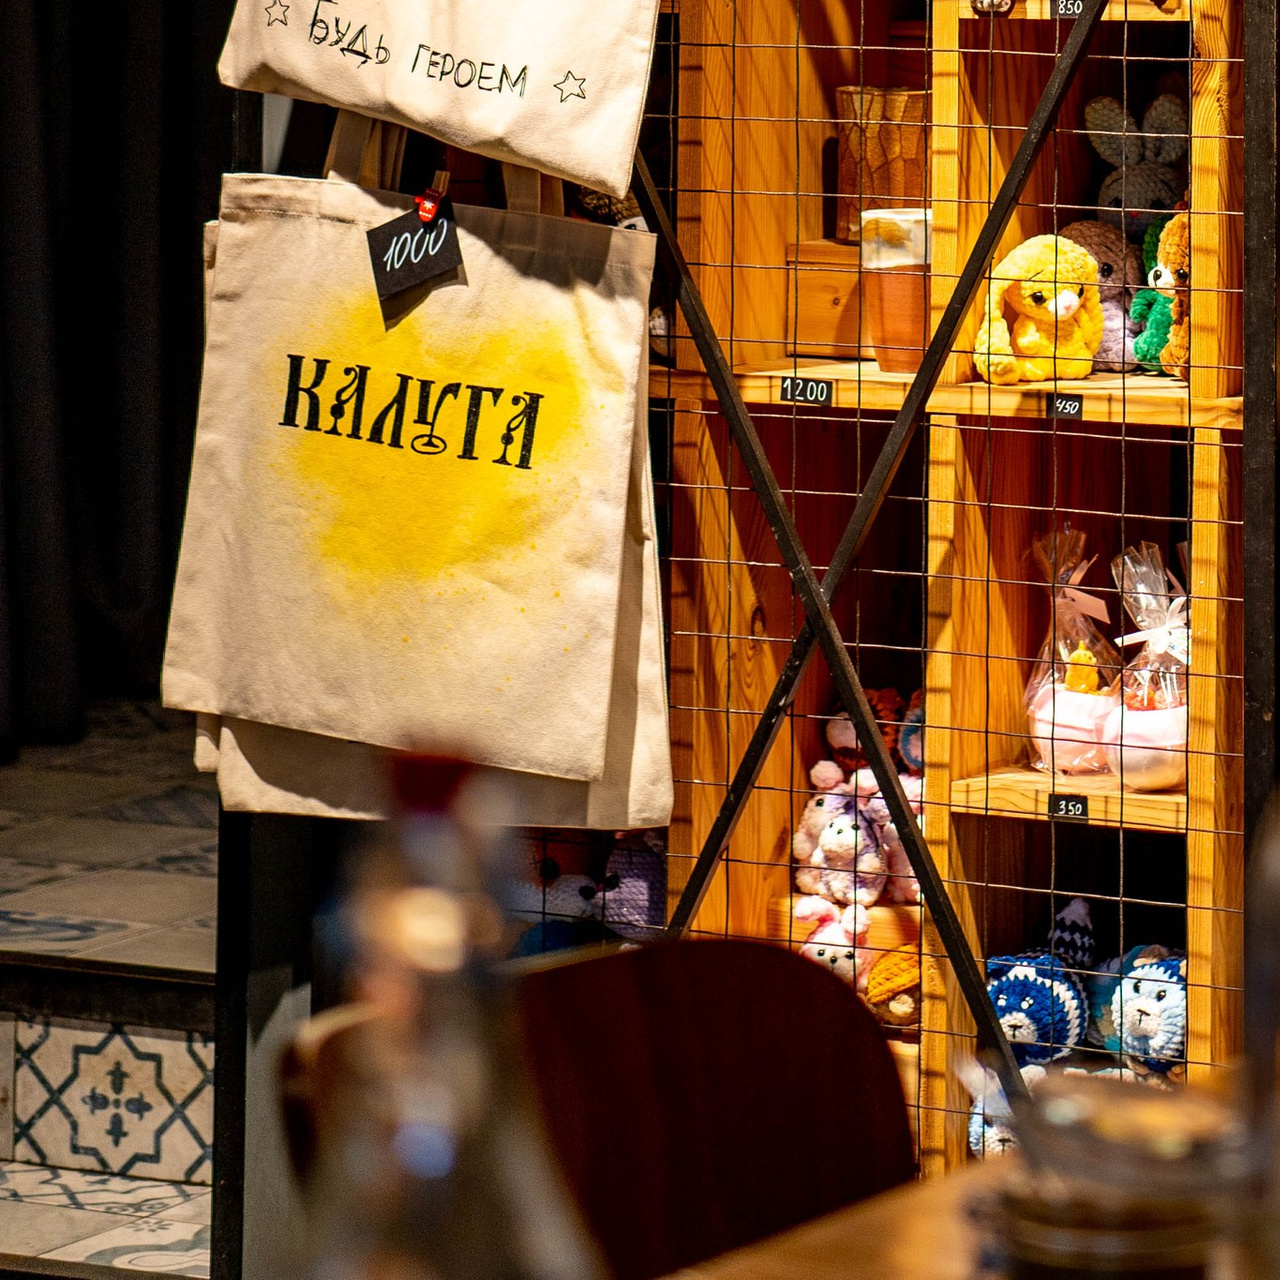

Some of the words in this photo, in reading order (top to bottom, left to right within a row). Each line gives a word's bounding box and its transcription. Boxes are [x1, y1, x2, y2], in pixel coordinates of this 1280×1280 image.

[383, 218, 448, 271] 1000
[783, 379, 827, 400] 1200
[278, 354, 545, 469] КАЛУГА
[1056, 398, 1080, 414] 450
[1058, 800, 1082, 815] 350
